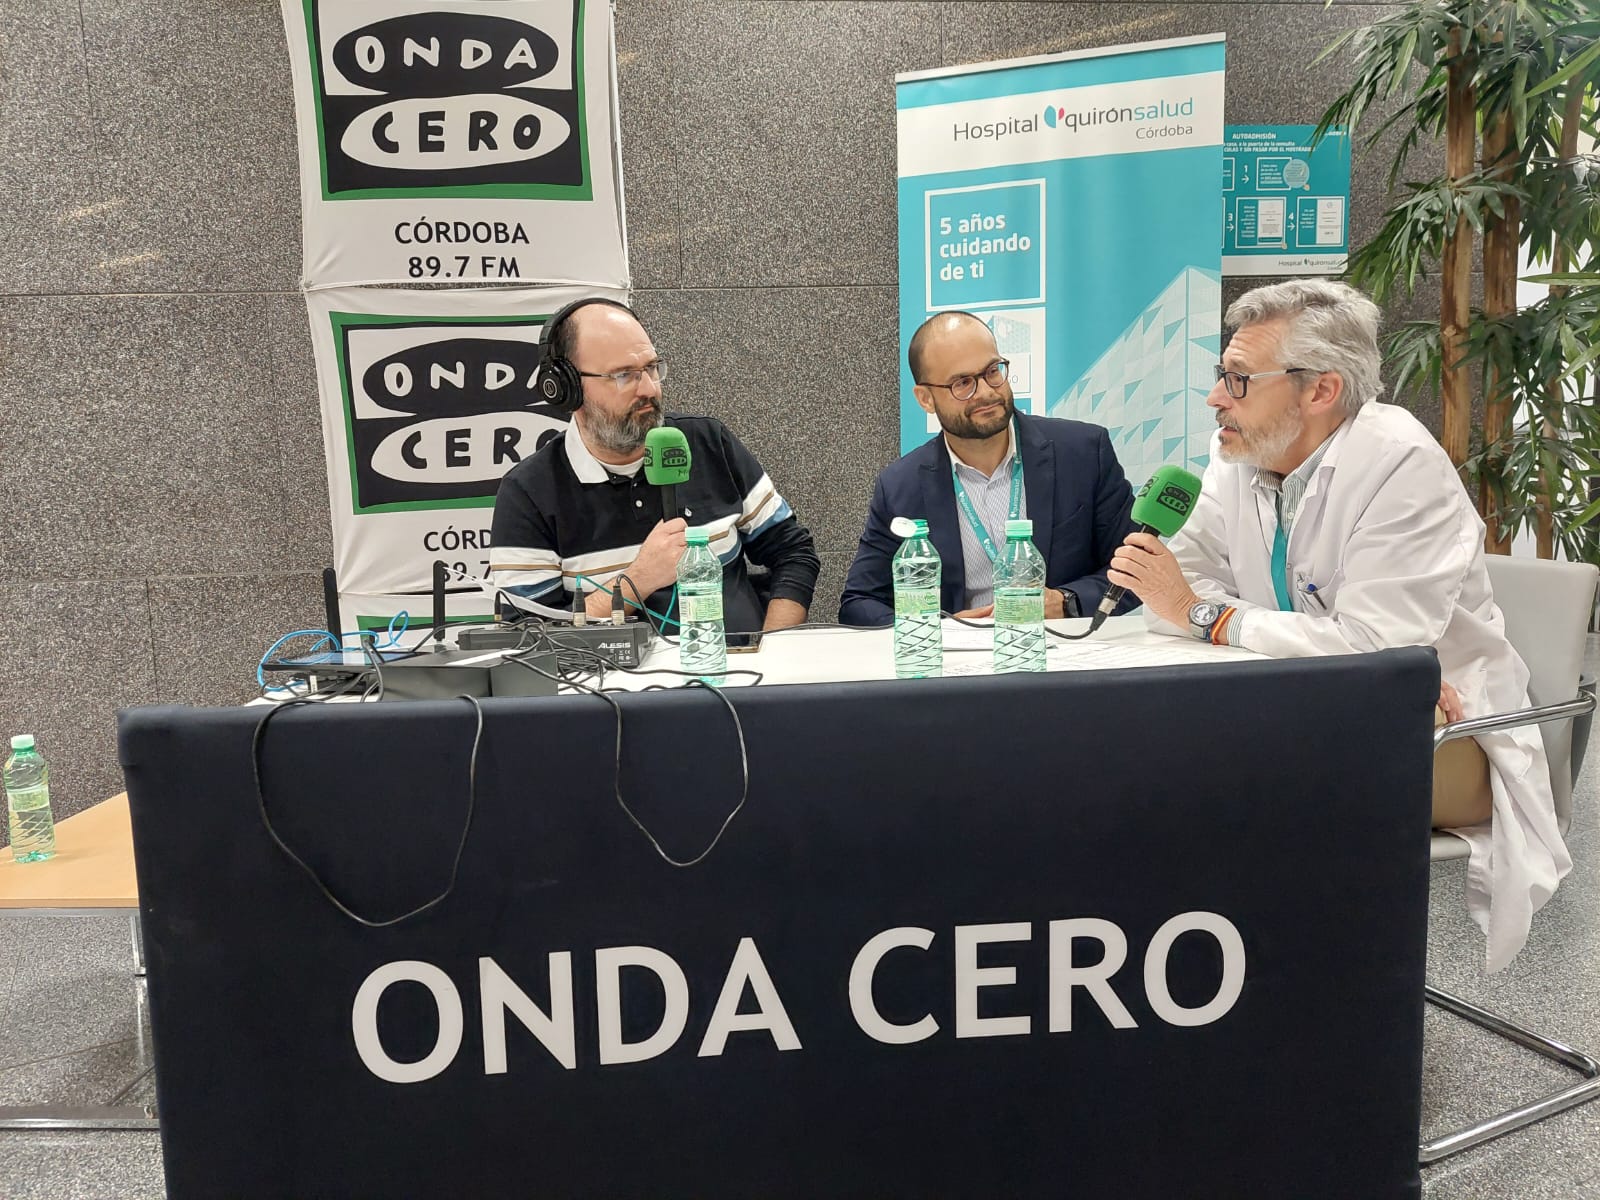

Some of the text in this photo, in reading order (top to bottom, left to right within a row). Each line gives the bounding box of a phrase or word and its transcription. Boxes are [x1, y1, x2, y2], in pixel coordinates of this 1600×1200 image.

[354, 35, 537, 73] ONDA
[953, 97, 1194, 141] Hospital quirónsalud
[371, 110, 541, 154] CERO
[1135, 124, 1194, 140] Córdoba
[1243, 164, 1248, 173] 1
[939, 213, 1006, 235] 5 años
[1227, 212, 1233, 221] 3
[1288, 212, 1294, 220] 4
[394, 216, 530, 245] CÓRDOBA
[939, 234, 1031, 258] cuidando
[407, 256, 521, 279] 89.7 FM
[939, 260, 984, 281] de ti
[352, 910, 1248, 1084] ONDA CERO
